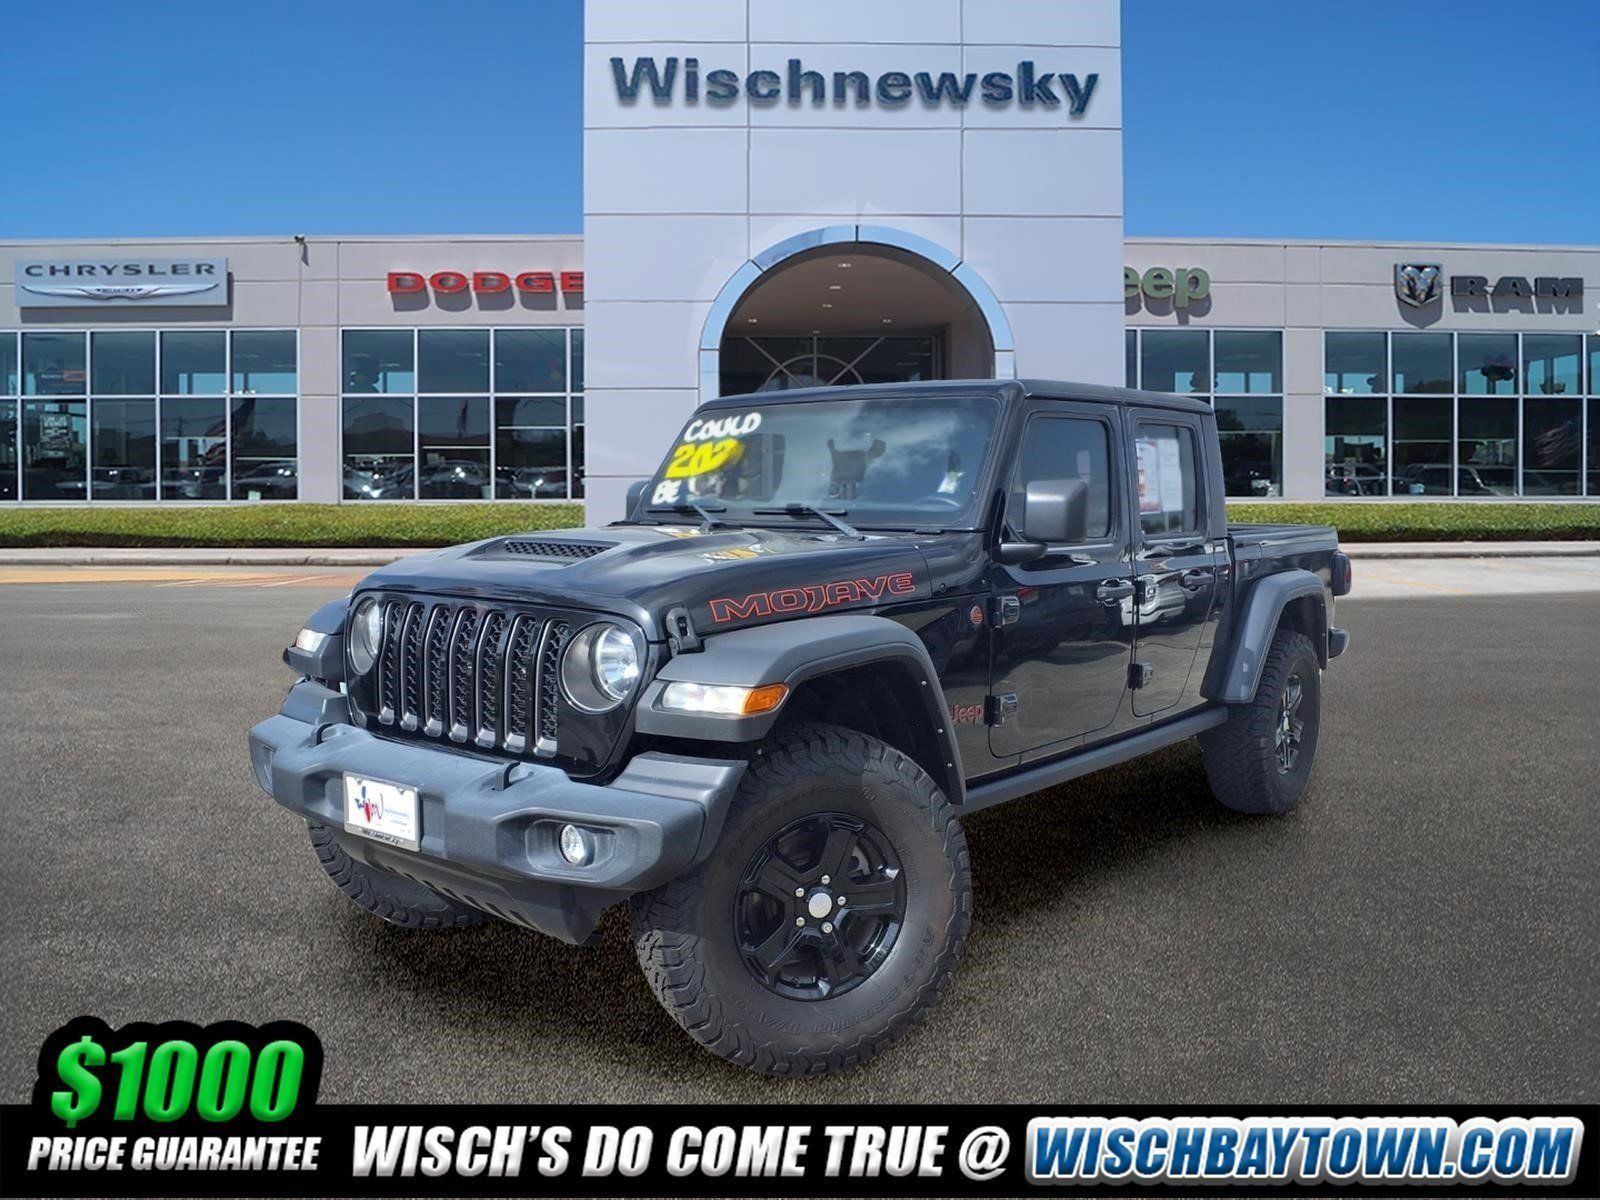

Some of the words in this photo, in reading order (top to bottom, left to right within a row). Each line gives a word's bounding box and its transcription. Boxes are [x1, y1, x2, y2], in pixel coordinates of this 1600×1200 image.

[609, 56, 1099, 116] Wischnewsky
[25, 263, 216, 277] CHRYSLER
[387, 272, 584, 292] DODGE
[1124, 266, 1211, 307] eep
[1450, 276, 1583, 296] RAM
[684, 412, 761, 442] COULD
[709, 572, 916, 623] MOJAVE
[950, 704, 983, 726] Jeep
